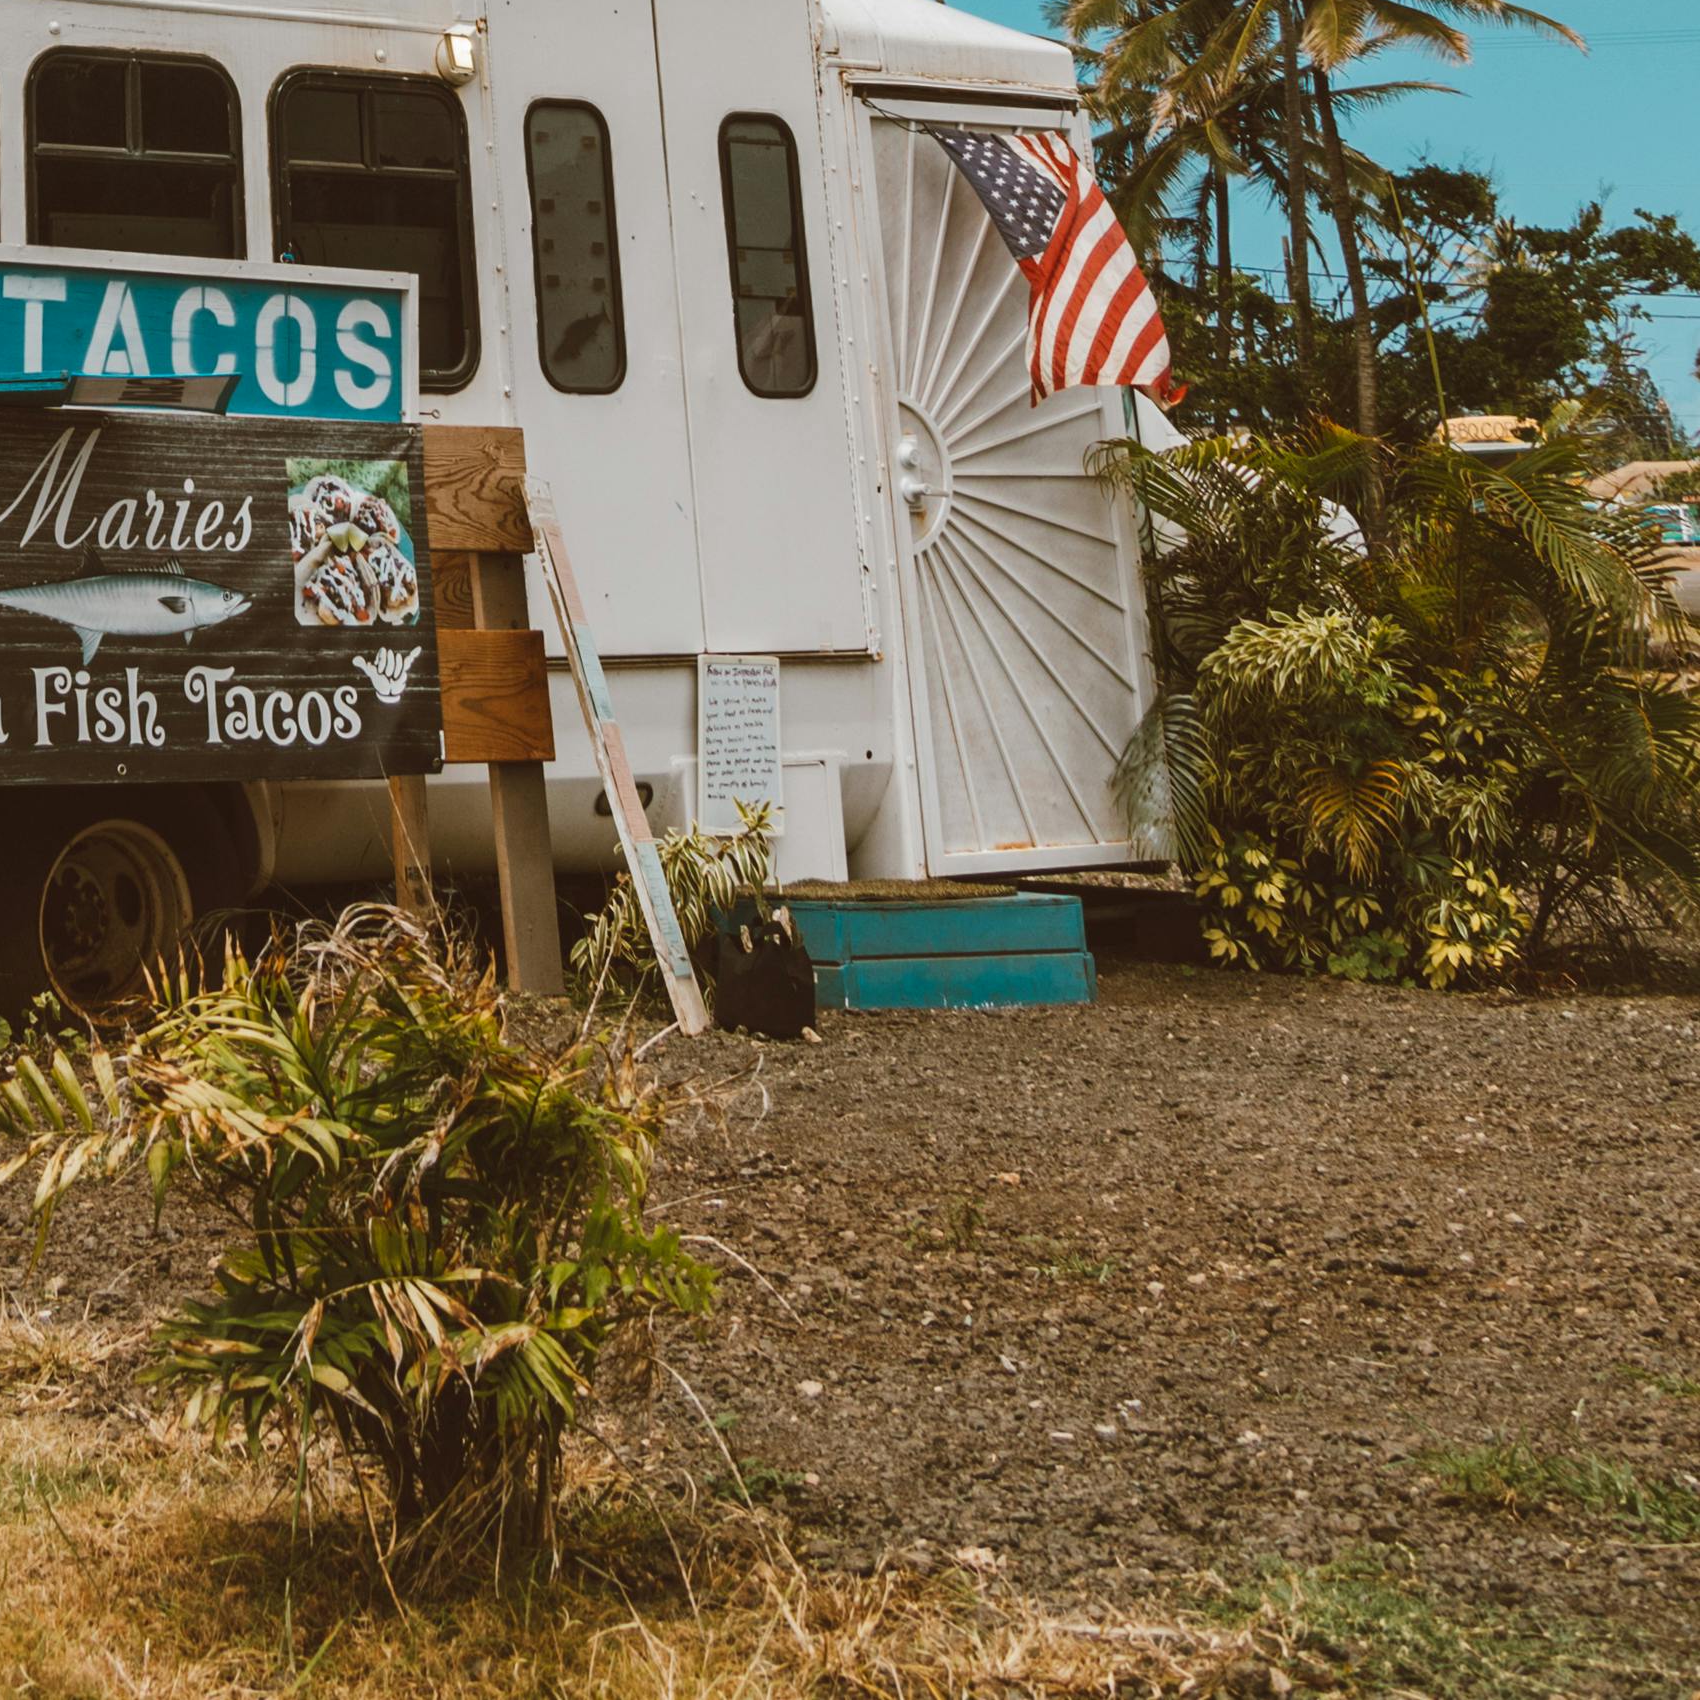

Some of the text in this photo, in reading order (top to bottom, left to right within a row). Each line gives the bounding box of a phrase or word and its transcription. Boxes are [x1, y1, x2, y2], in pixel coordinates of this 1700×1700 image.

[3, 276, 393, 410] TACOS
[31, 666, 166, 747] Fish
[185, 665, 362, 746] Tacos
